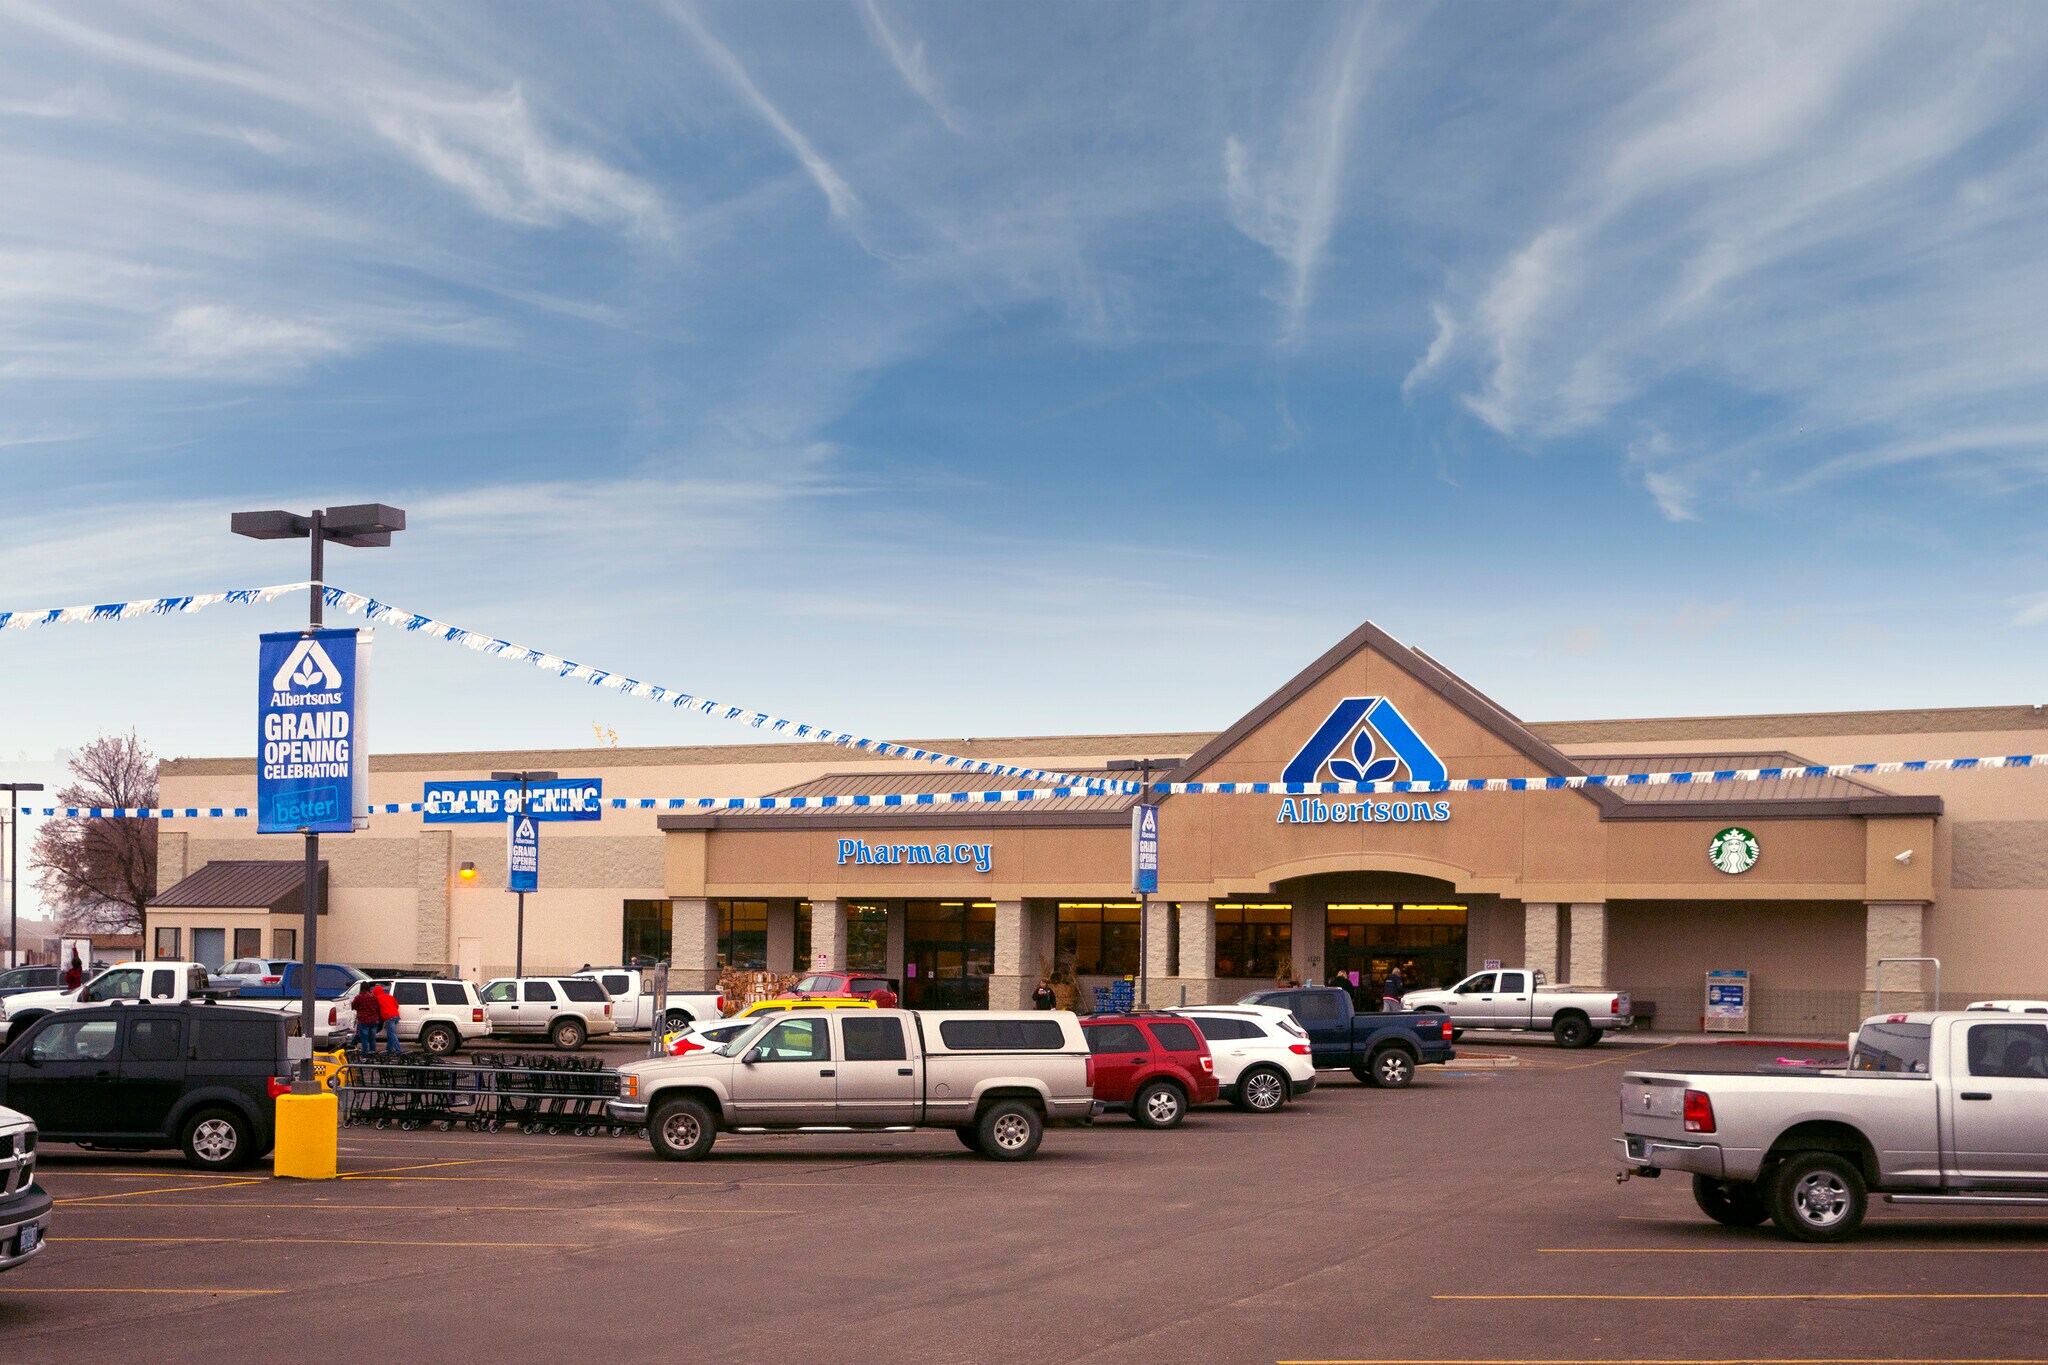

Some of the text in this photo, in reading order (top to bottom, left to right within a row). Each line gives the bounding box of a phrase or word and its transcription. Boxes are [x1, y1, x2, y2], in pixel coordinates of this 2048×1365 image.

[270, 692, 342, 706] Albertsons
[264, 711, 349, 740] GRAND
[264, 740, 349, 764] OPENING
[263, 763, 348, 779] CELEBRATION
[276, 799, 334, 822] better
[427, 789, 499, 814] GRAND
[1277, 798, 1450, 823] Albertsons
[512, 856, 537, 866] OPENING
[513, 845, 537, 857] GRAND
[837, 839, 992, 873] Pharmacy
